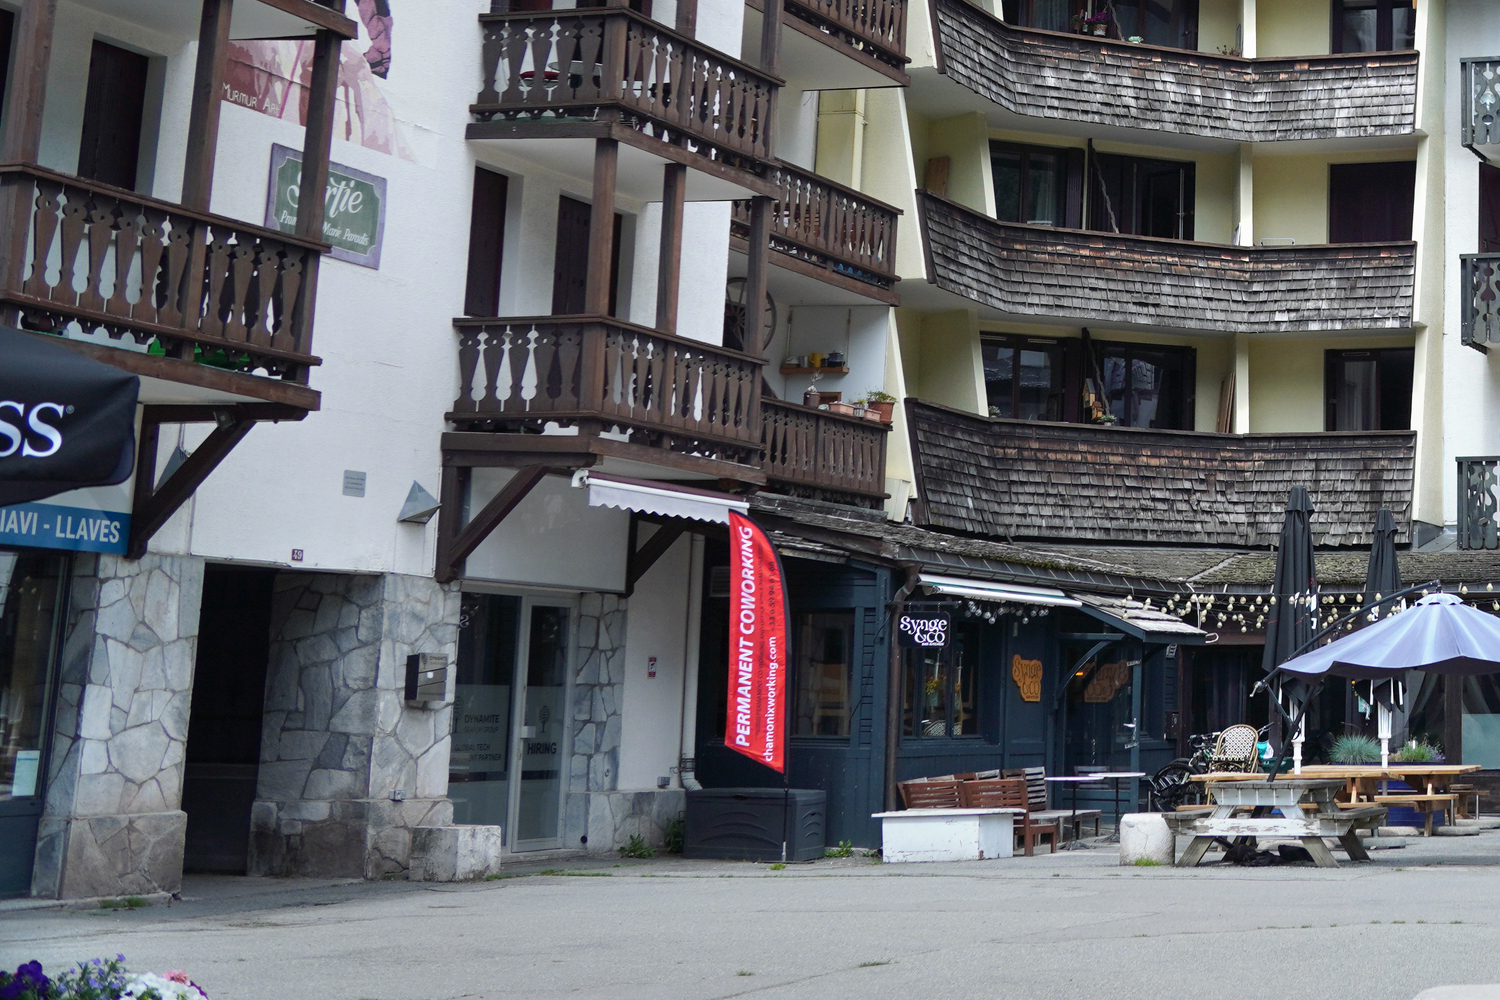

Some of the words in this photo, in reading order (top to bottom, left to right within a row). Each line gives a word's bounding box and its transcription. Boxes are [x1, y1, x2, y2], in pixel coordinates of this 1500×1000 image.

[342, 231, 369, 246] Paradis
[55, 515, 121, 544] LLAVES
[292, 550, 303, 560] 49
[738, 526, 756, 635] COWORKING
[900, 615, 948, 635] Synge
[735, 636, 754, 747] PERMANENT
[763, 636, 779, 762] chamonixworking.com
[464, 714, 500, 724] DYNAMITE
[454, 743, 474, 751] GLOBAL
[476, 742, 491, 751] TECH
[527, 742, 557, 755] HIRING
[478, 752, 502, 762] PARTNER
